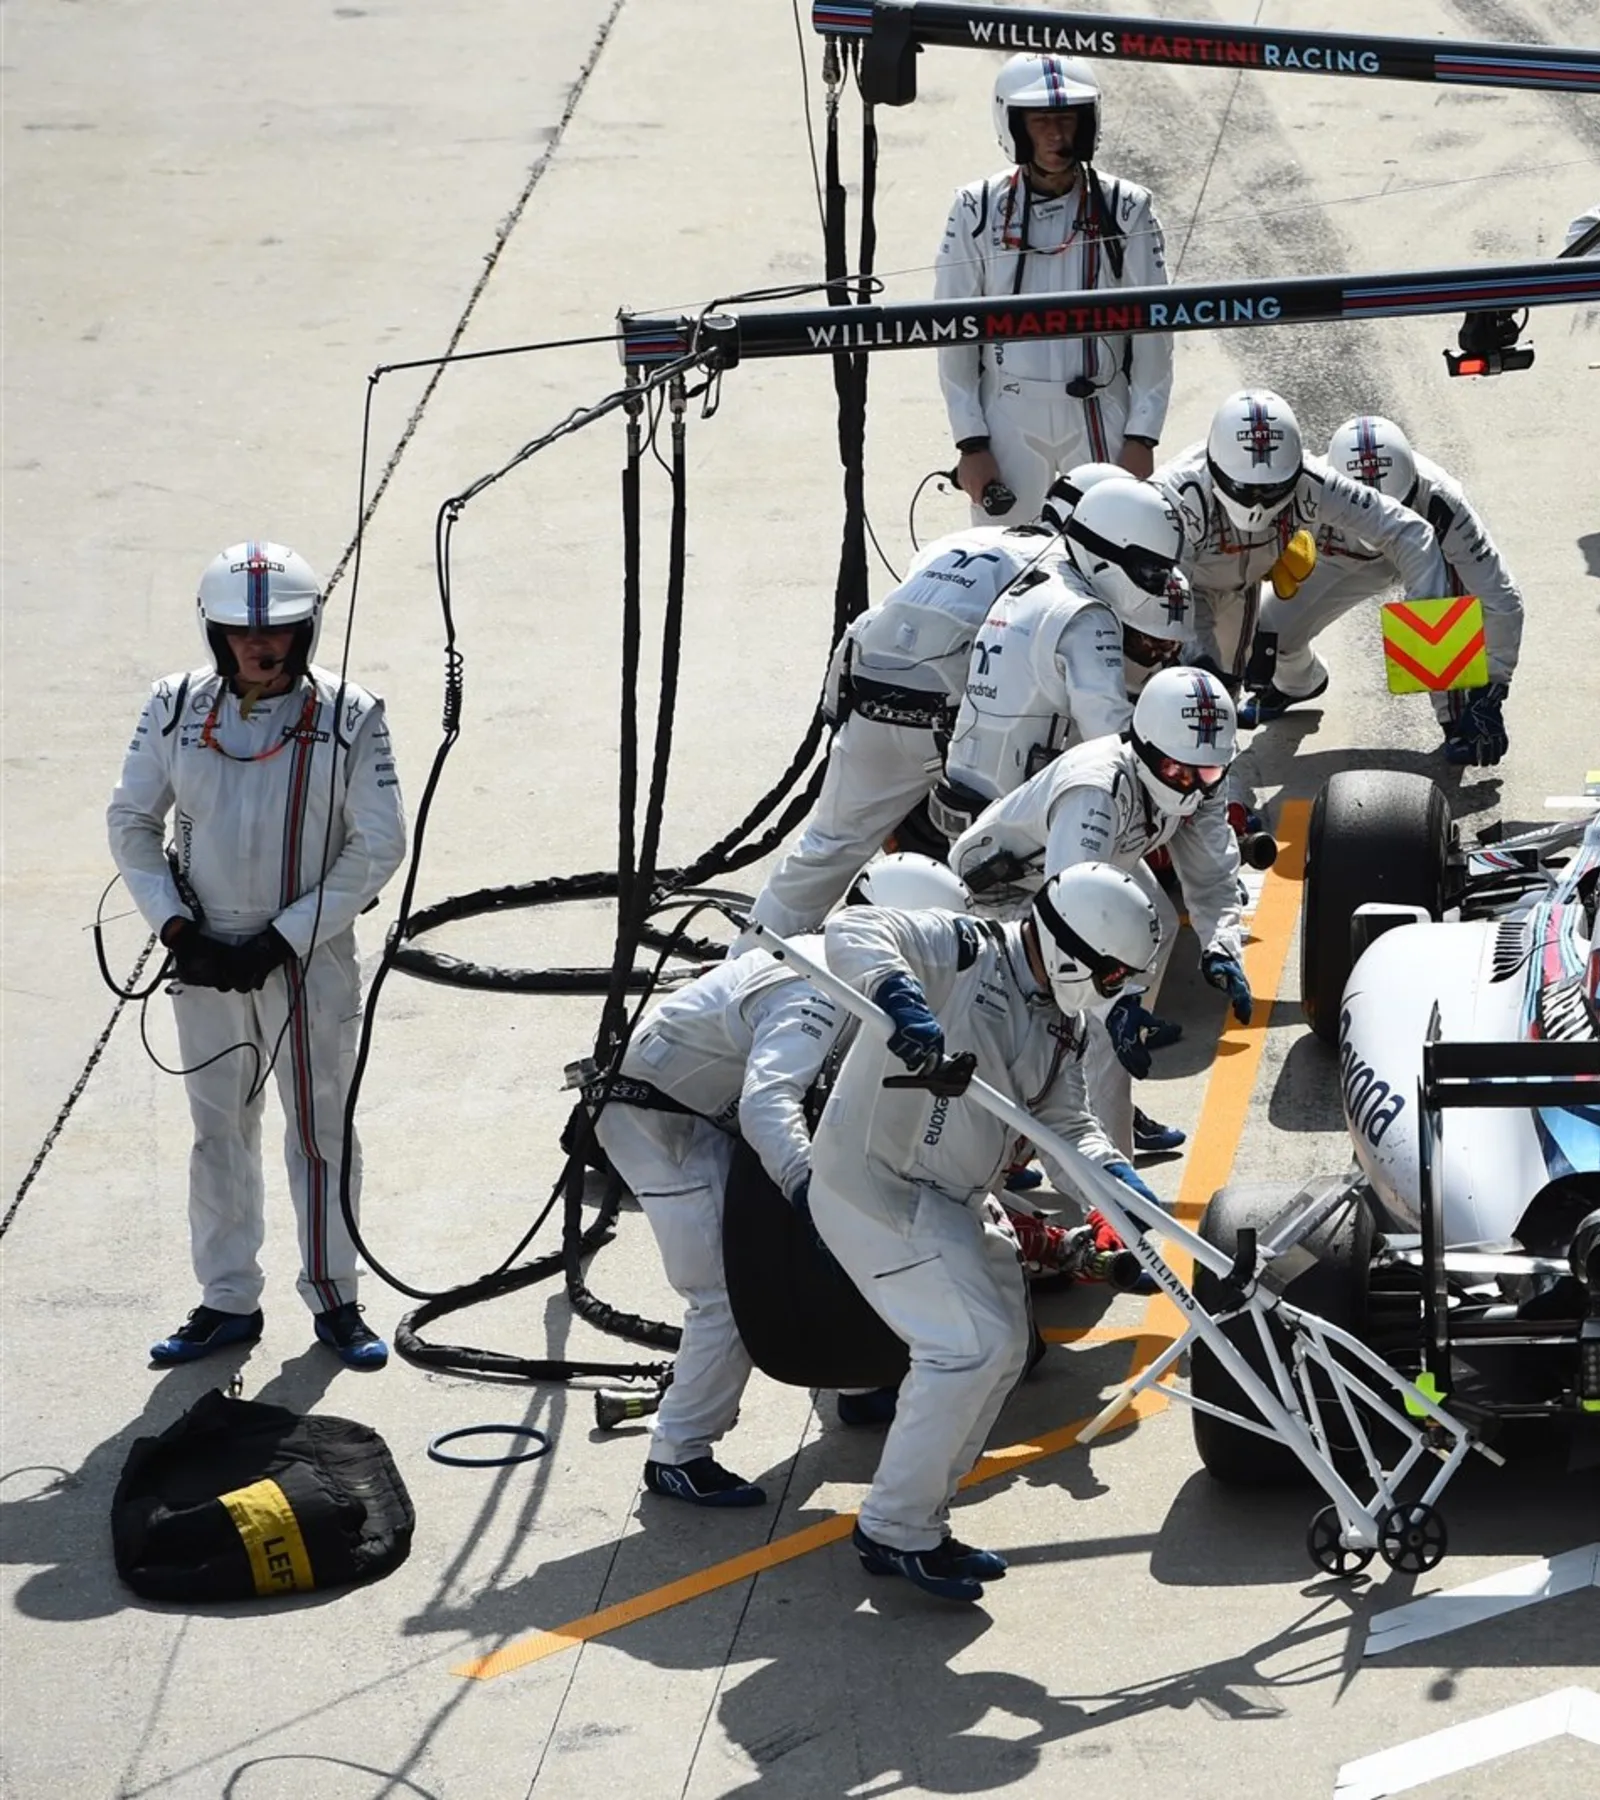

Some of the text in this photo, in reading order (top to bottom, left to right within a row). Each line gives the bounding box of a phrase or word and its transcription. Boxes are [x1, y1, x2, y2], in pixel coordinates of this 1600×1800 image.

[967, 19, 1380, 74] WILLIAMS MARTINI RACING
[806, 296, 1282, 349] WILLIAMS MARTINI RACING
[1237, 430, 1284, 441] MARTINI
[1347, 457, 1393, 471] MARTINI
[231, 562, 285, 573] MARTINI
[922, 569, 978, 590] randstad
[966, 681, 998, 700] andstad
[1182, 707, 1229, 720] MARTINI
[923, 1096, 951, 1147] exona
[1136, 1238, 1196, 1311] WILLIAMS
[263, 1536, 298, 1592] LEF
